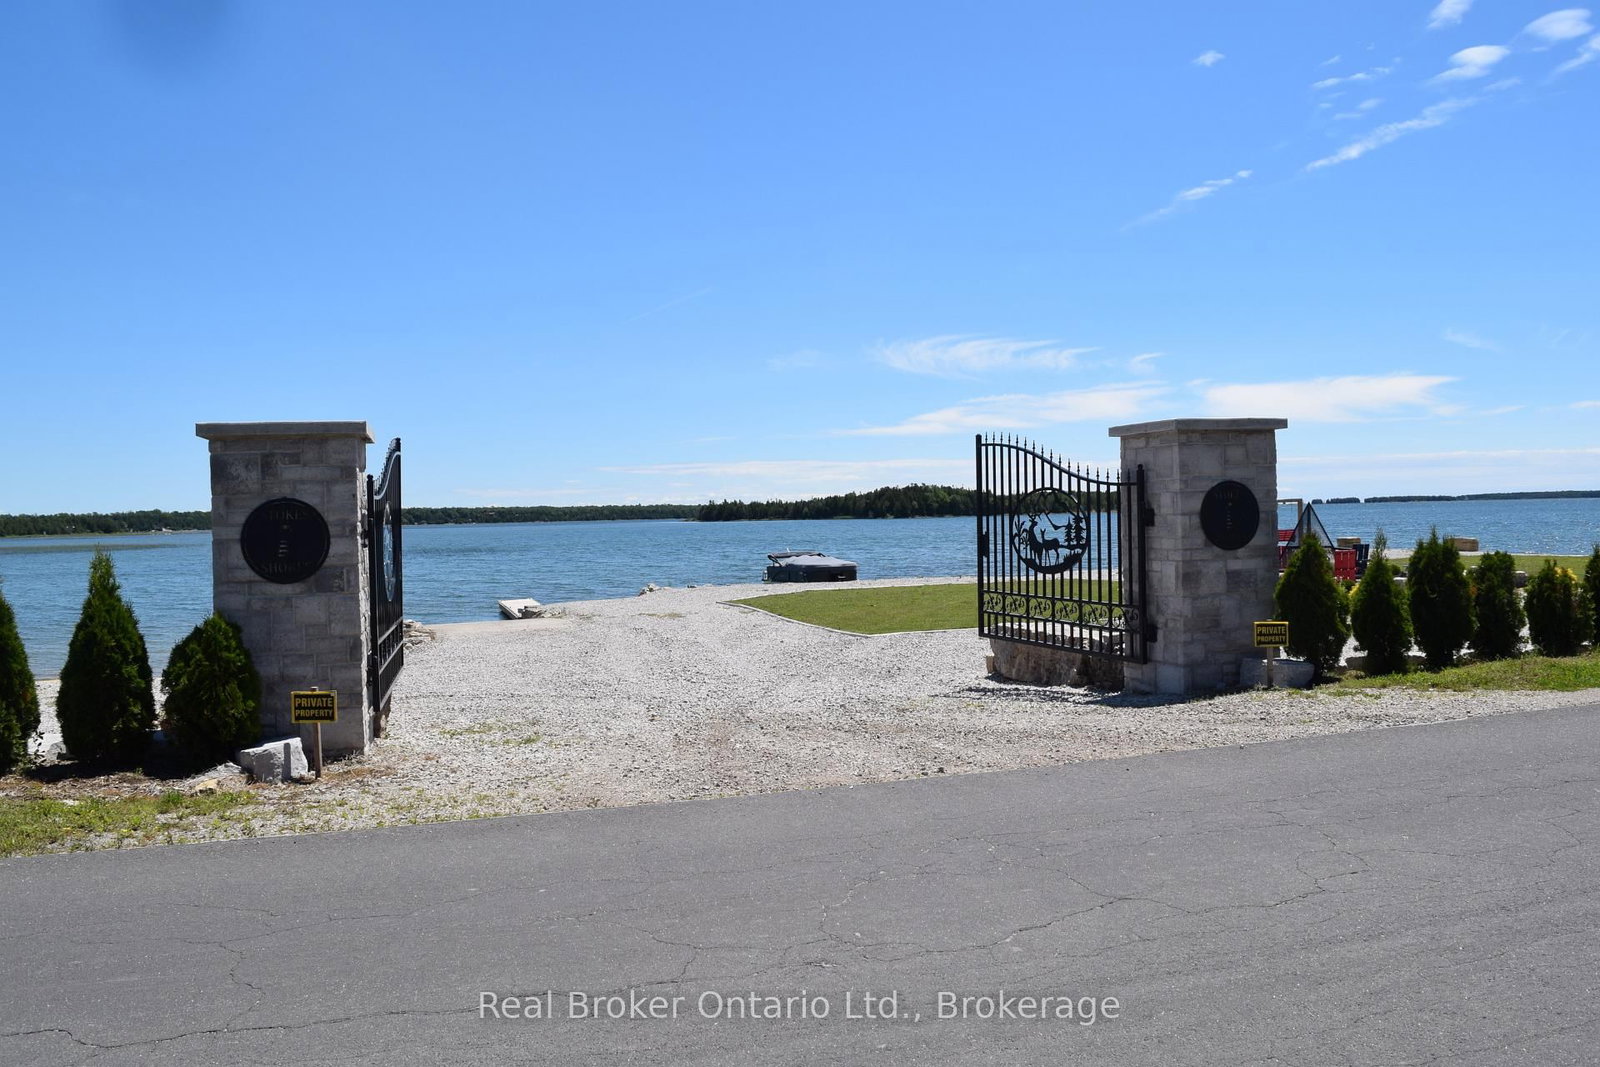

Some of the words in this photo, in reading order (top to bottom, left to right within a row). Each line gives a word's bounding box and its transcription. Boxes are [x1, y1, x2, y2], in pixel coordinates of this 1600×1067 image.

[1257, 626, 1286, 634] PRIVATE
[295, 697, 333, 707] PRIVATE
[295, 709, 333, 717] PROPERTY
